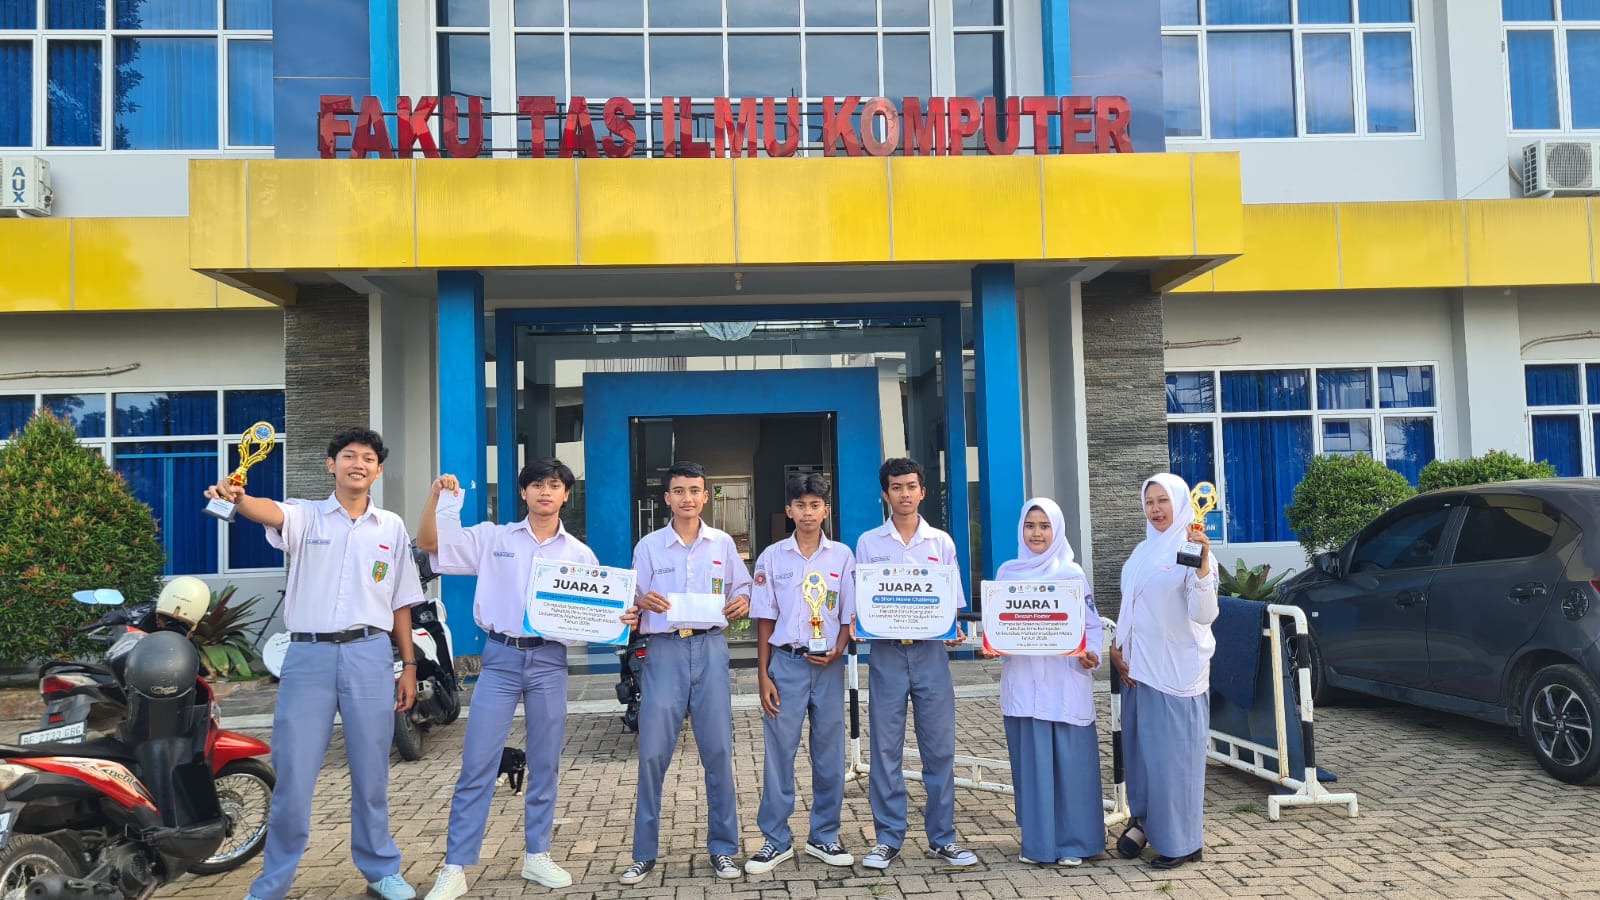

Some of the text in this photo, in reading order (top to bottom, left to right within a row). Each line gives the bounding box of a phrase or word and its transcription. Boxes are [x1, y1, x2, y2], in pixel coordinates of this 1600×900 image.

[662, 95, 801, 159] ILMU
[823, 95, 1134, 158] KOMPUTER
[12, 166, 26, 203] AUX
[553, 579, 610, 595] JUARA 2
[878, 583, 933, 592] JUARA 2
[1005, 599, 1059, 609] JUARA 1
